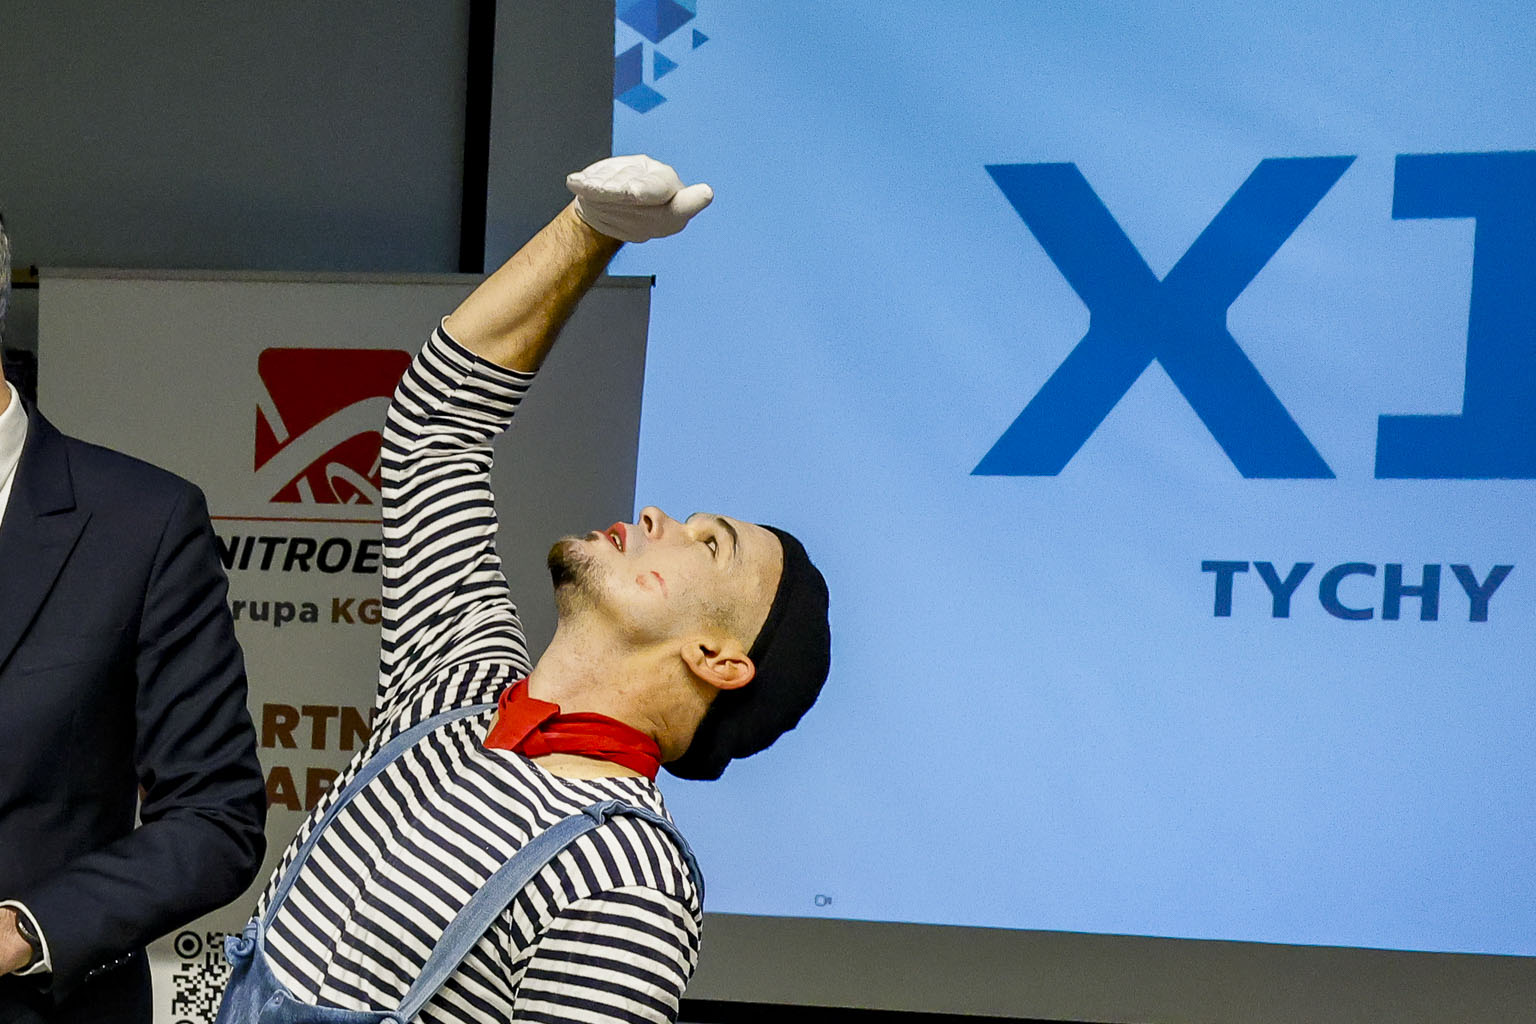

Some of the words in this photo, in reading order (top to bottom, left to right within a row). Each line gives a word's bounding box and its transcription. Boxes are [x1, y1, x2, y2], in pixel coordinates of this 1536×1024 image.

[216, 534, 382, 574] NITROE
[1201, 560, 1515, 622] TYCHY
[232, 599, 319, 628] rupa
[331, 597, 382, 626] KG
